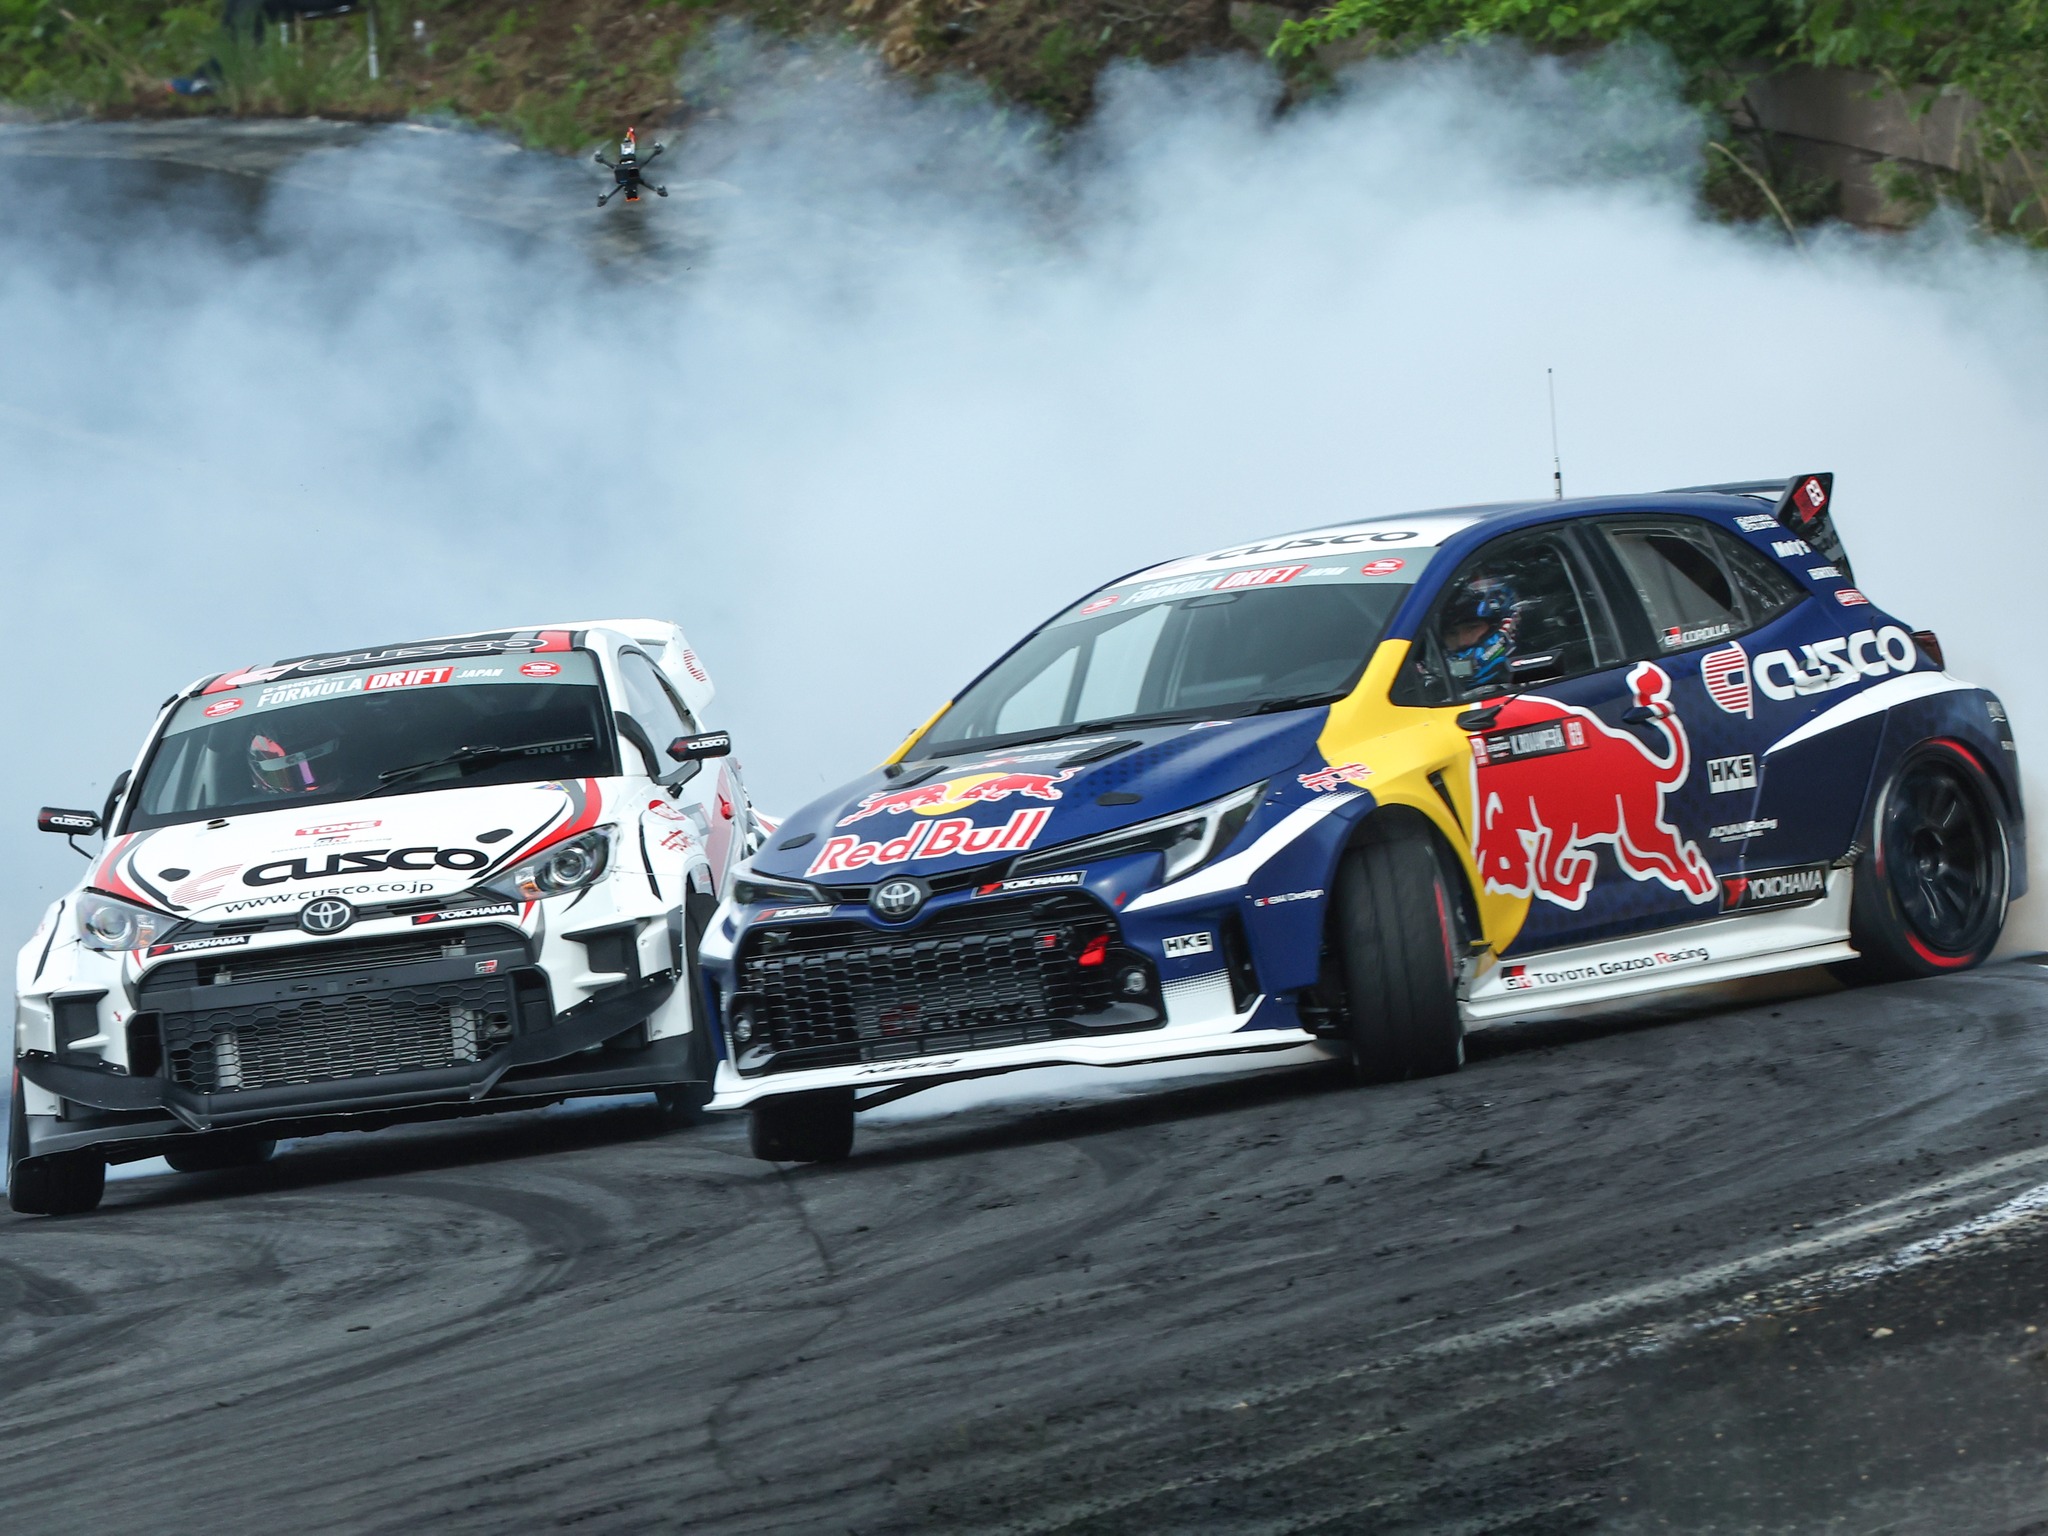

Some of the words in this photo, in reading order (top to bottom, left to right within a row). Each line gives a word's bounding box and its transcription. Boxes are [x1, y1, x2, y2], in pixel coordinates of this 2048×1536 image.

[1217, 566, 1306, 589] DRIFT
[1682, 623, 1731, 643] COROLLA
[1752, 625, 1917, 701] CUSCO
[256, 677, 363, 708] FORMULA
[370, 667, 449, 690] DRIFT
[456, 668, 505, 679] JAPAN
[1709, 757, 1753, 783] HKS
[804, 819, 934, 877] Red
[911, 806, 1055, 860] Bull
[242, 846, 490, 887] CUSCO
[1002, 873, 1079, 890] YOKOHAMA
[1747, 869, 1824, 900] YOKOHAMA
[225, 881, 434, 913] www.cusco.co.jp
[438, 904, 516, 920] YOKOHAMA
[173, 936, 246, 952] YOKOHAMA
[1165, 933, 1210, 952] HKS
[1533, 966, 1598, 985] TOYOTA
[1599, 956, 1655, 975] GAZOO
[1654, 946, 1710, 966] Racing
